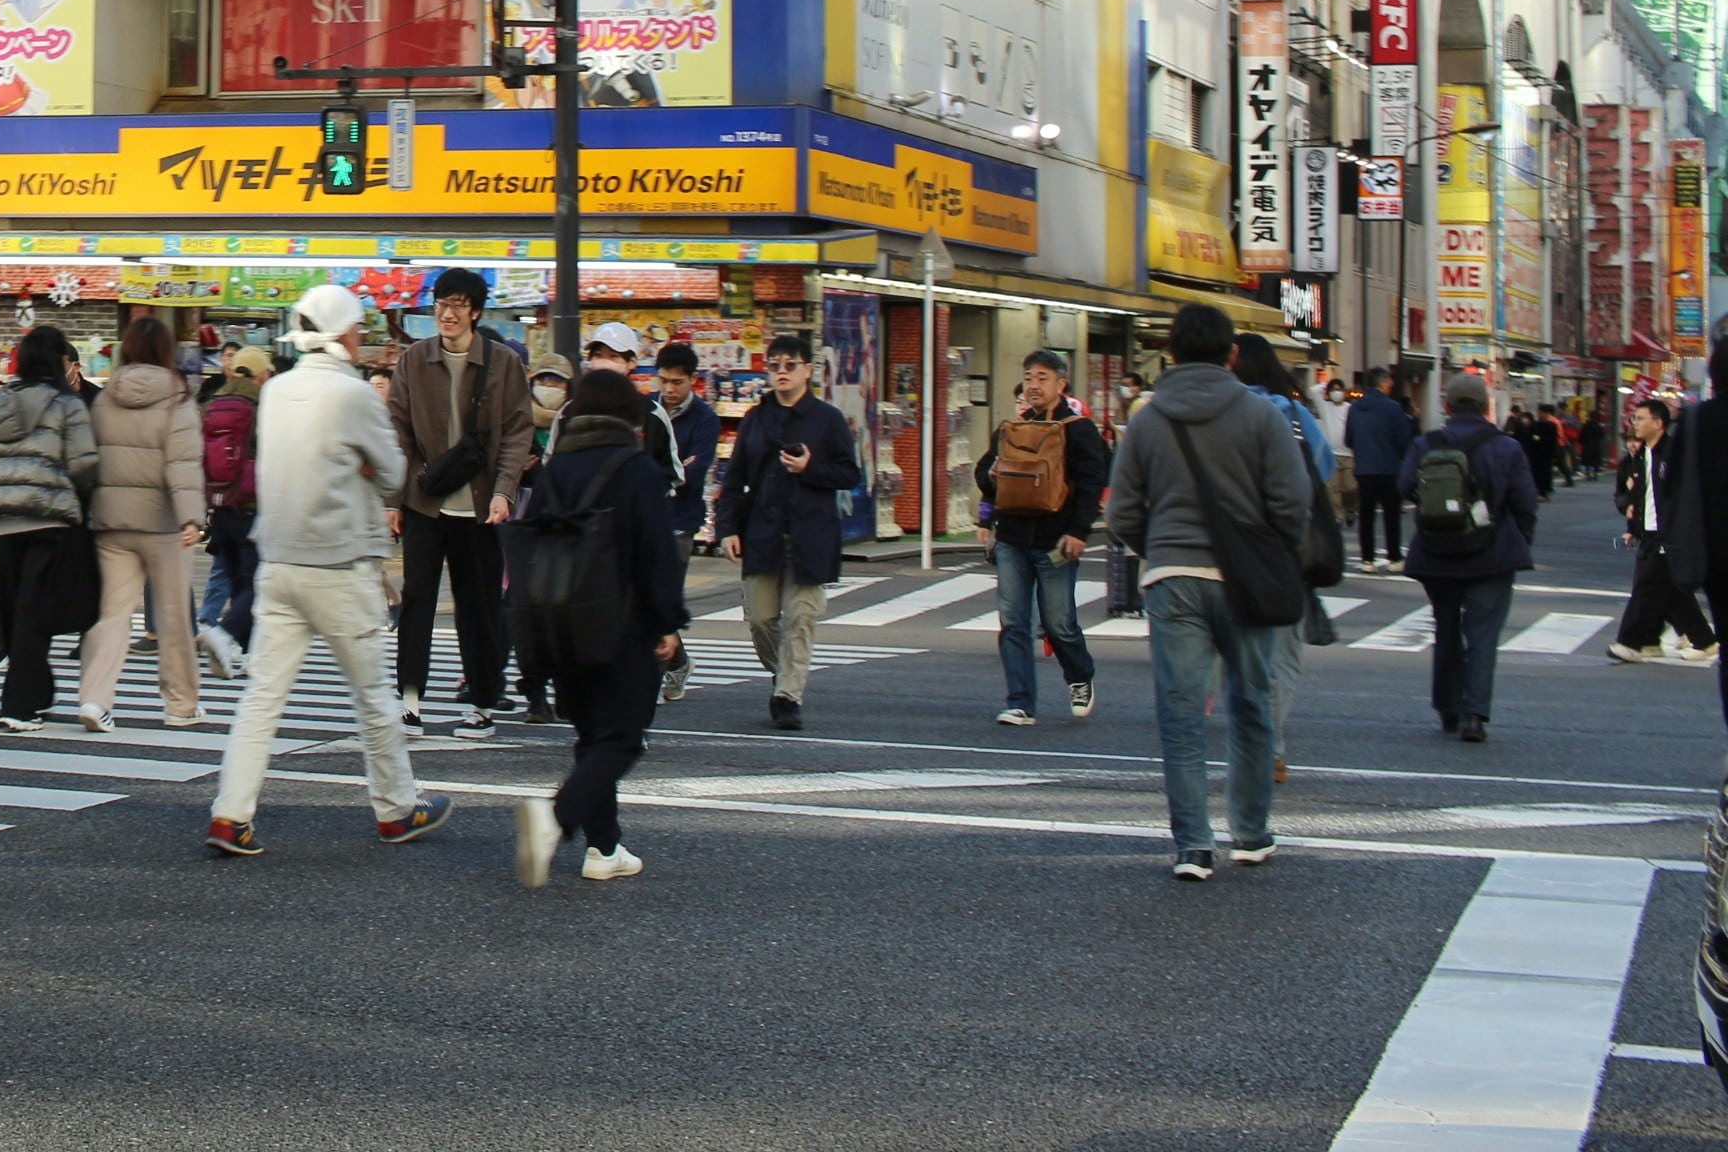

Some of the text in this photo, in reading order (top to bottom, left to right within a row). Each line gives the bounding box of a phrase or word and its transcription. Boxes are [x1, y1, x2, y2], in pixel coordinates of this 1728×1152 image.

[1248, 64, 1278, 242] オヤイデ電気
[16, 173, 117, 196] KiYoshi
[628, 168, 745, 194] KiYoshi
[1437, 266, 1481, 288] ME
